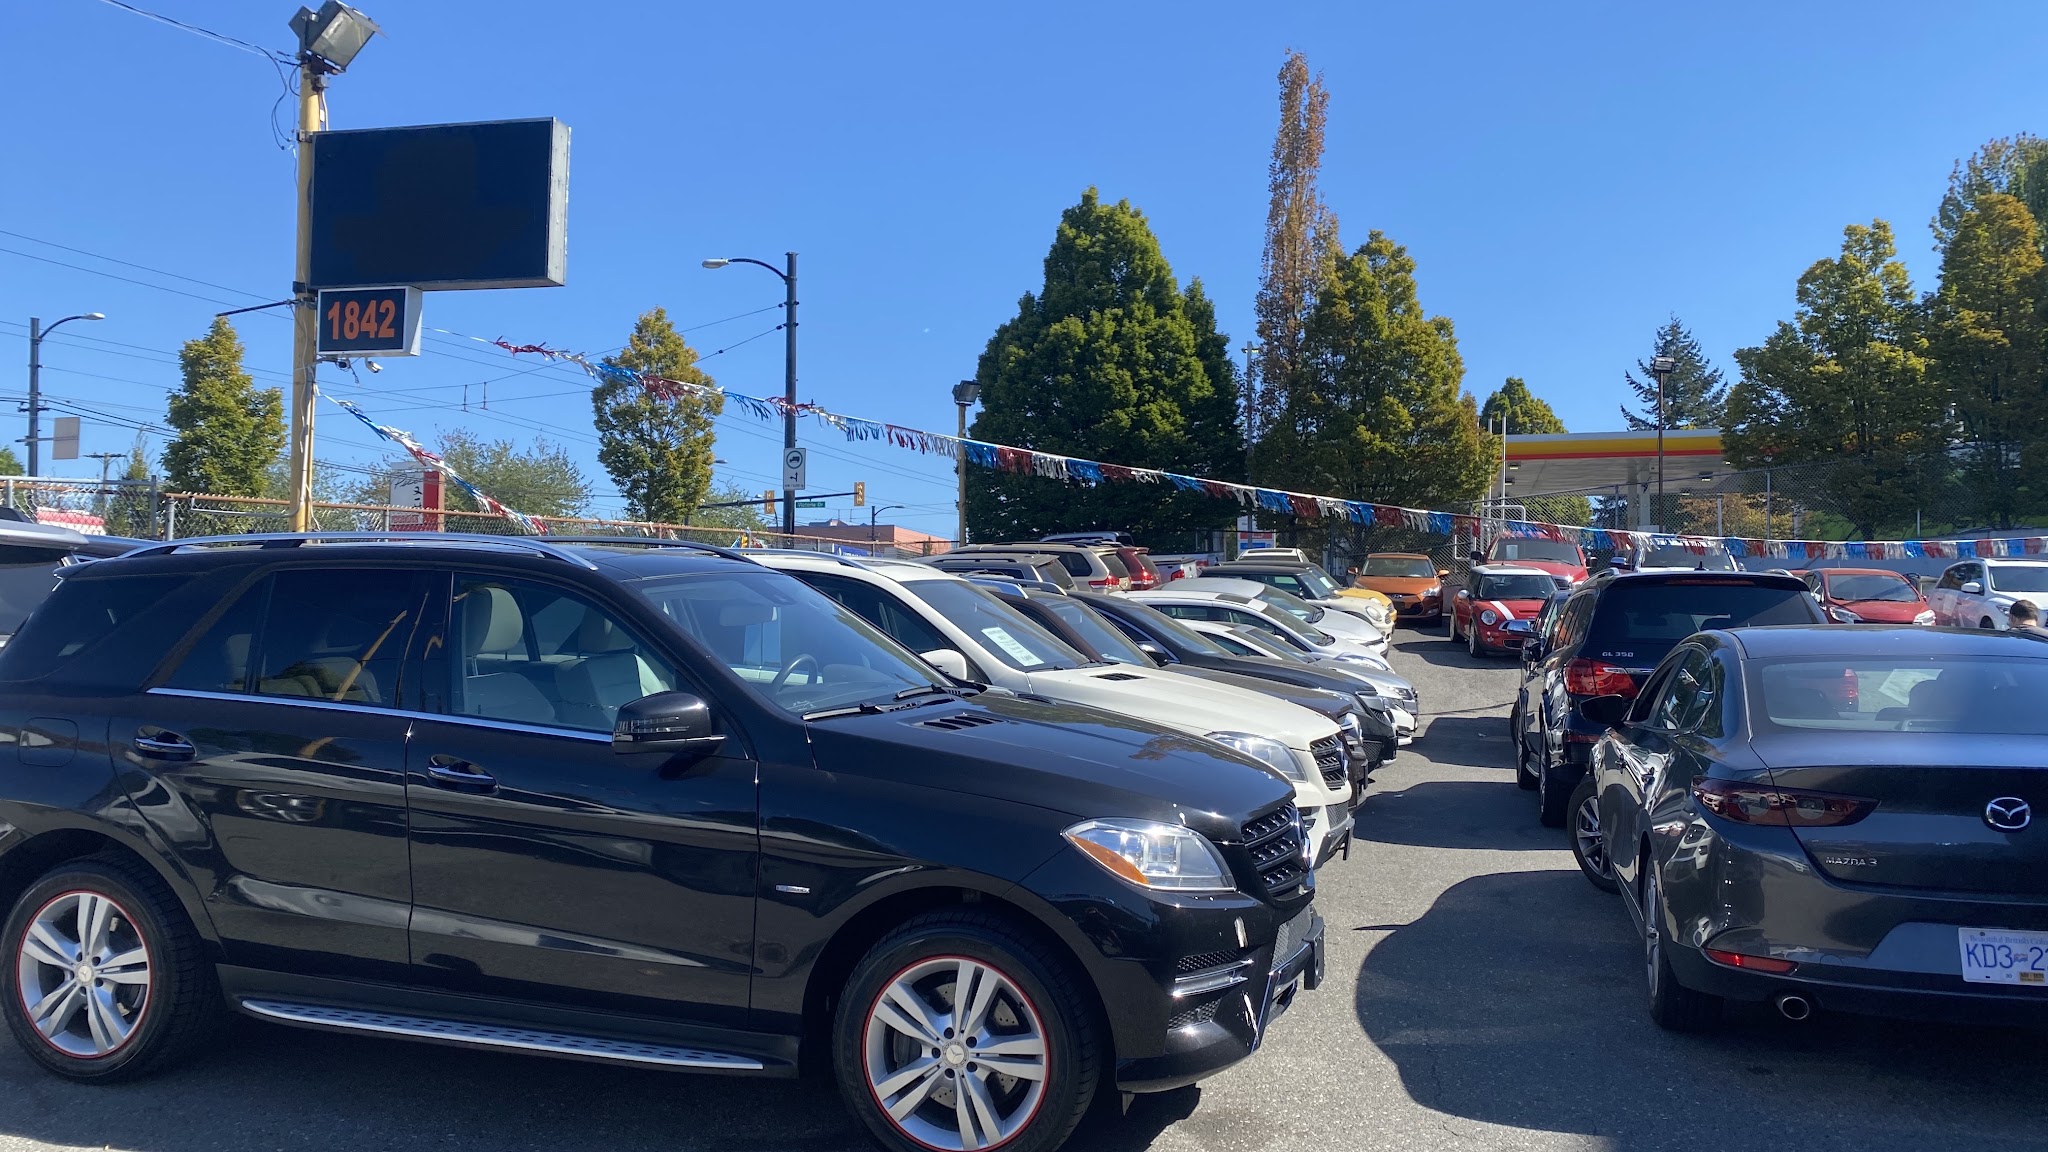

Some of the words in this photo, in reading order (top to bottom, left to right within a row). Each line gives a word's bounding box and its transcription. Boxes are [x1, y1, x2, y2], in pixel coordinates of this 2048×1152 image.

[328, 299, 396, 340] 1842
[1825, 856, 1866, 866] MAZDA
[1869, 858, 1878, 867] 3
[1965, 943, 2014, 969] KD3
[2029, 947, 2048, 971] 2
